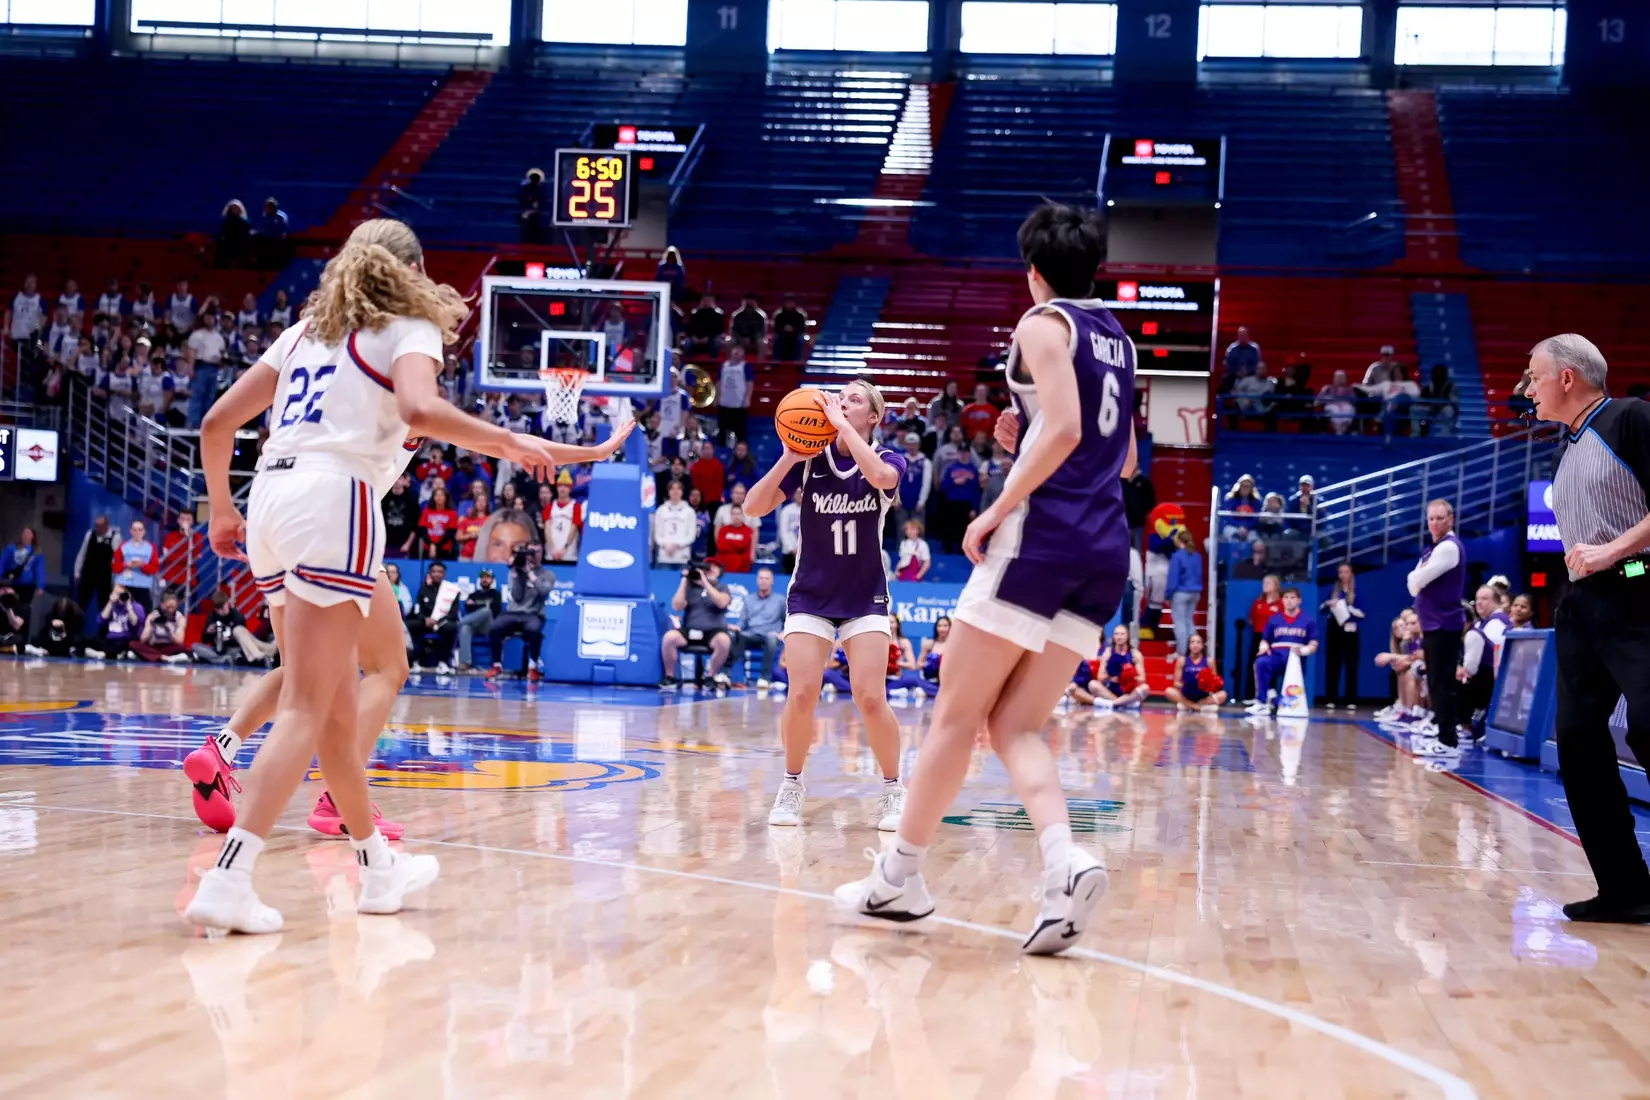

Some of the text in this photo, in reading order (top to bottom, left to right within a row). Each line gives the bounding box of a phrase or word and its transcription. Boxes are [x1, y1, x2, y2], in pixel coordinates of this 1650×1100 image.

[717, 5, 738, 30] 11
[1145, 13, 1172, 38] 12
[1598, 17, 1625, 43] 13
[637, 130, 676, 142] TOYOTA
[1154, 143, 1195, 155] TOYOTA
[576, 157, 623, 180] 6:50
[568, 180, 616, 218] 25
[1138, 286, 1185, 299] TOYOTA
[1090, 332, 1125, 369] GARCIA
[278, 364, 337, 429] 22
[1097, 371, 1120, 438] 6
[787, 432, 830, 449] Wilson
[813, 491, 878, 514] Wildcats
[830, 519, 858, 556] 11
